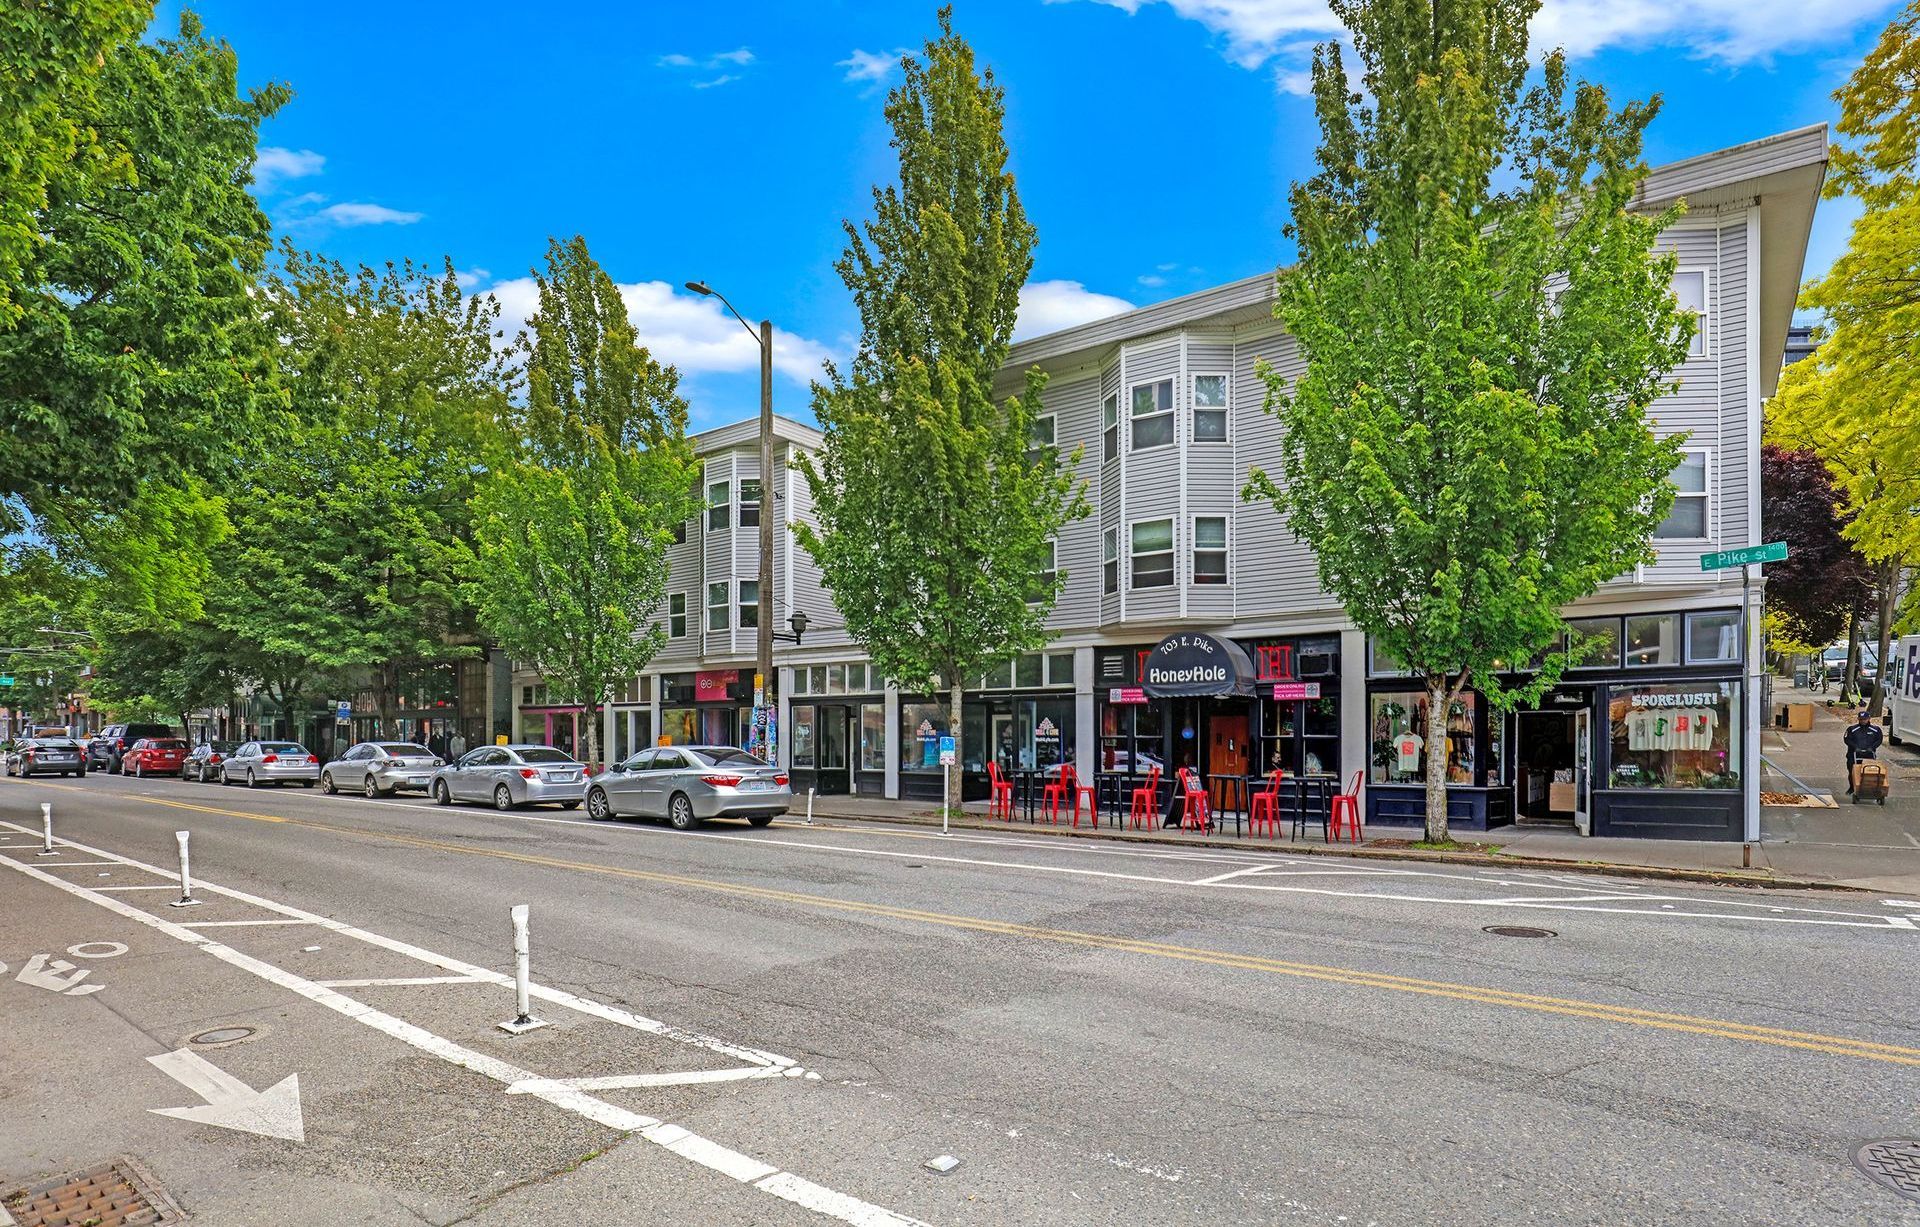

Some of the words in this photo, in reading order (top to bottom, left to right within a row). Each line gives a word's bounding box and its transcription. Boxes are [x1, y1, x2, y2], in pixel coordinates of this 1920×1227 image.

[1768, 543, 1785, 552] 1400
[1704, 558, 1712, 568] E
[1717, 552, 1748, 566] Pike
[1754, 550, 1767, 560] St
[1160, 639, 1178, 655] 703
[1181, 636, 1190, 647] E.
[1193, 637, 1214, 655] Pike
[1149, 665, 1226, 684] HoneyHole
[1631, 692, 1718, 707] SPORELUST!
